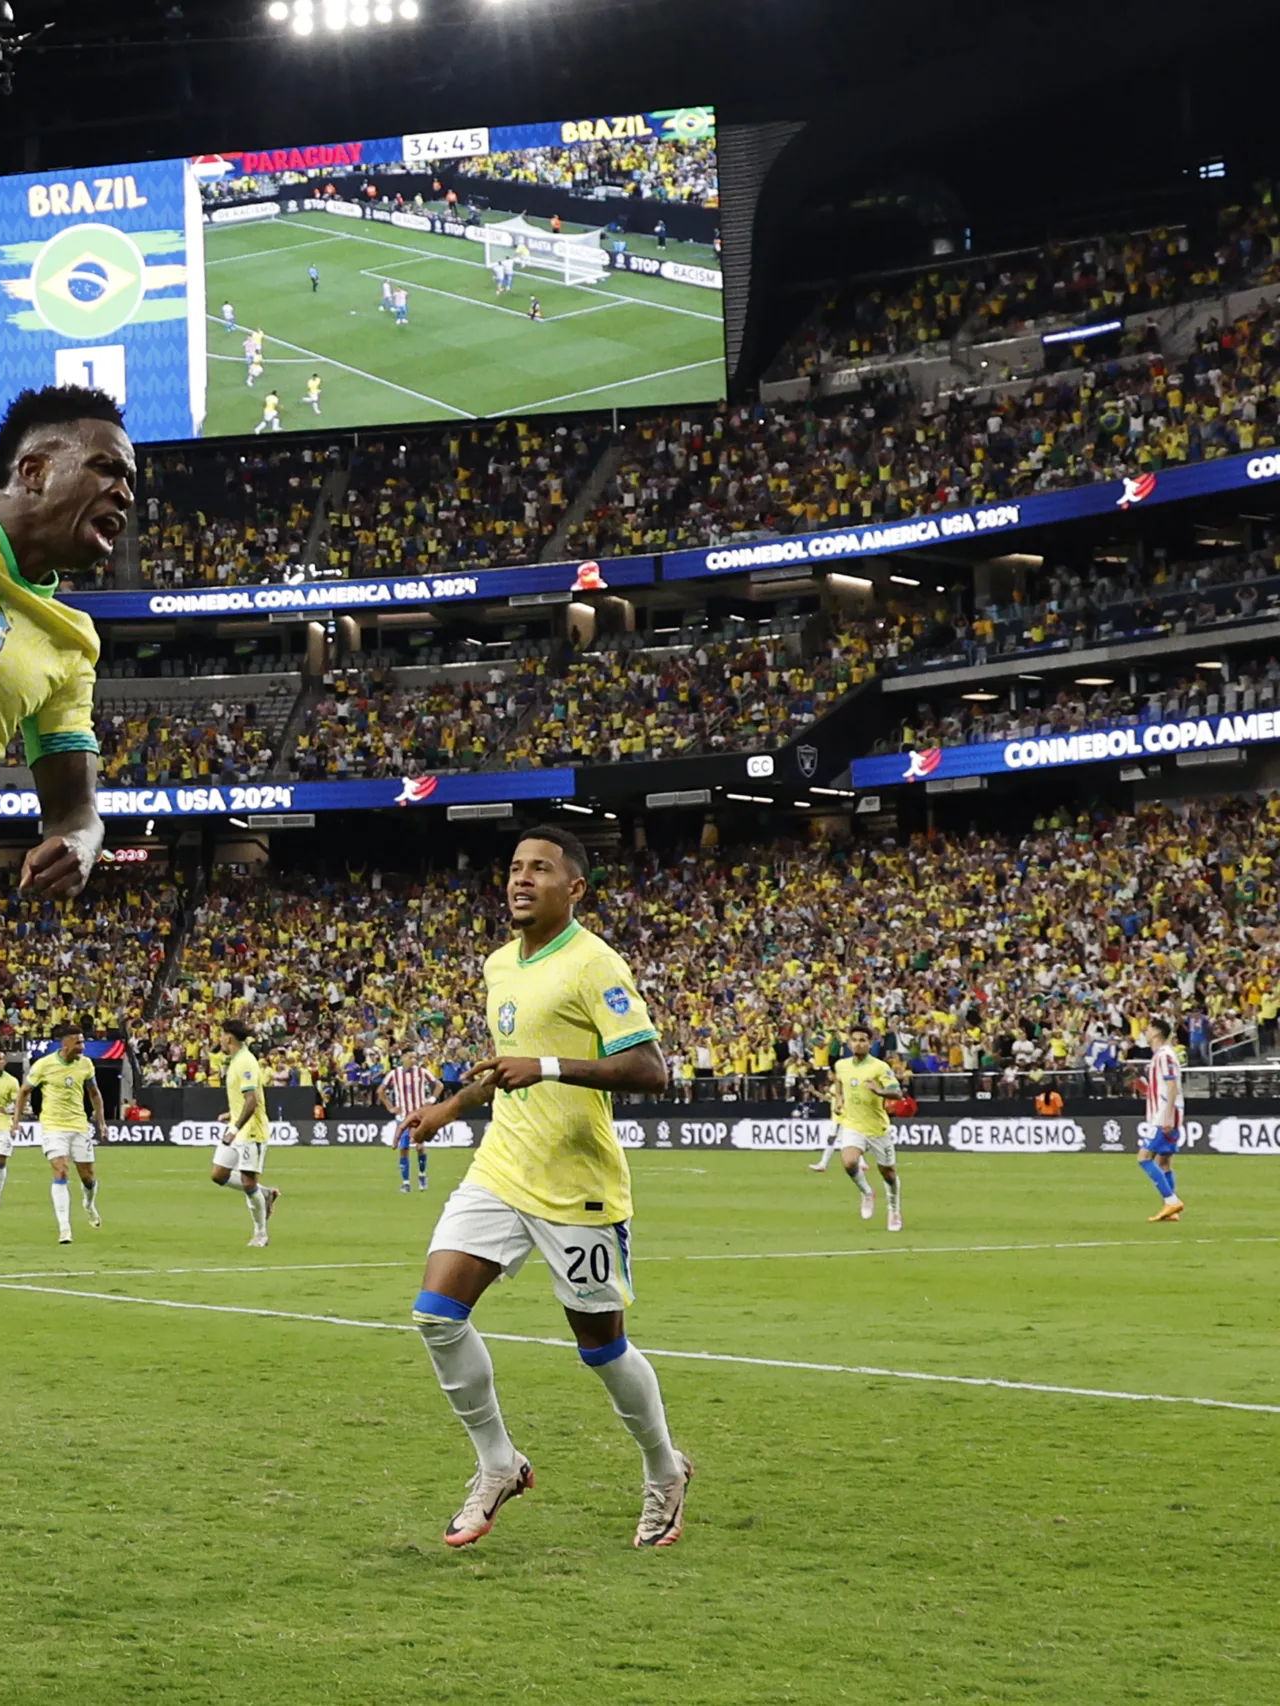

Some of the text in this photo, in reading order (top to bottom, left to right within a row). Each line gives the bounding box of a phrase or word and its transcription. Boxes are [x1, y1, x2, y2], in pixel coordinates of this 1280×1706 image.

[561, 115, 653, 143] BRAZIL
[242, 142, 363, 173] PARAGUAY
[408, 132, 483, 156] 34:45
[28, 176, 148, 217] BRAZIL
[630, 256, 716, 283] STOP RACISM
[82, 360, 94, 388] 1
[706, 505, 1019, 572] CONMEBOL COPA AMERICA USA 2024
[149, 578, 478, 613] CONMEBOL COPA AMERICA USA 2024
[1004, 731, 1143, 768] CONMEBOL
[1142, 722, 1216, 752] COPA
[751, 760, 770, 774] CC
[177, 788, 227, 812] USA
[230, 785, 293, 810] 2024
[108, 1125, 164, 1142] BASTA
[182, 1126, 204, 1140] DE
[337, 1123, 378, 1143] STOP
[680, 1123, 820, 1145] STOP RACISM
[890, 1124, 1076, 1146] BASTA DE RACISMO
[563, 1243, 611, 1285] 20
